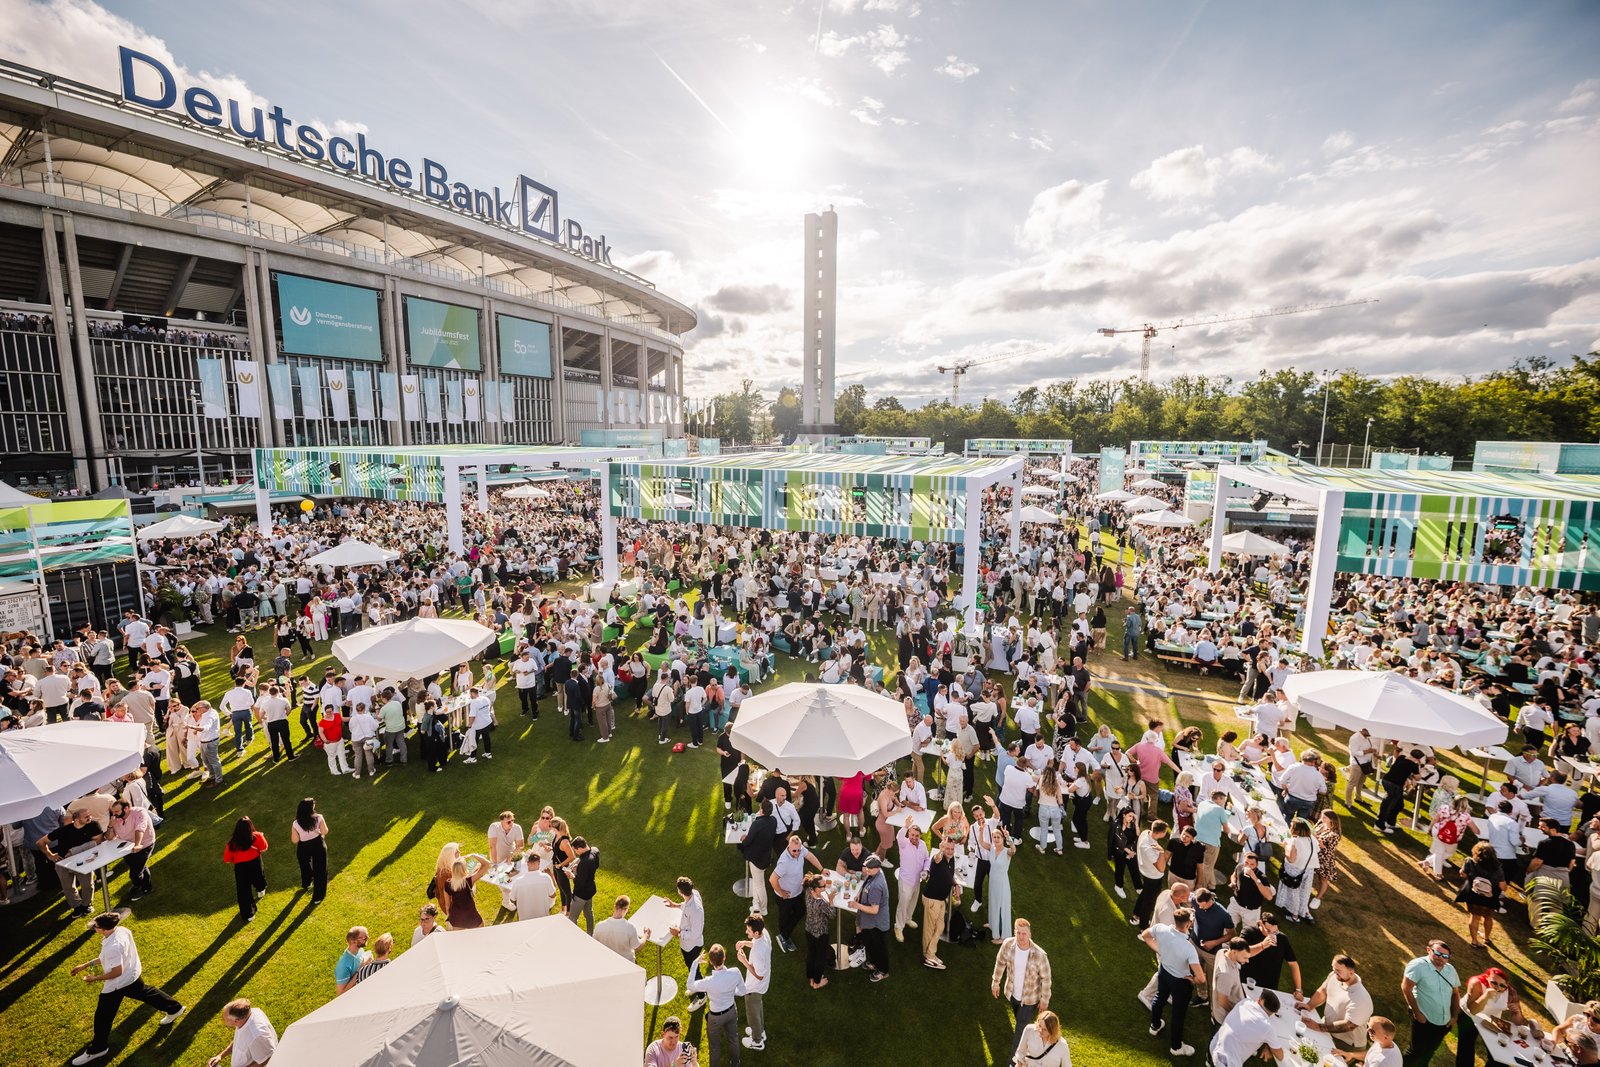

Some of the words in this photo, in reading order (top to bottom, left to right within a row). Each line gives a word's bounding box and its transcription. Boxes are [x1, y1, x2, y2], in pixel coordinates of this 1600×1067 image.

[118, 45, 413, 190] Deutsche
[422, 157, 513, 226] Bank
[566, 218, 613, 266] Park
[315, 311, 343, 321] Deutsche
[315, 318, 373, 332] Vermögensberatung
[420, 327, 470, 341] Jubiläumsfest
[514, 339, 527, 355] 50
